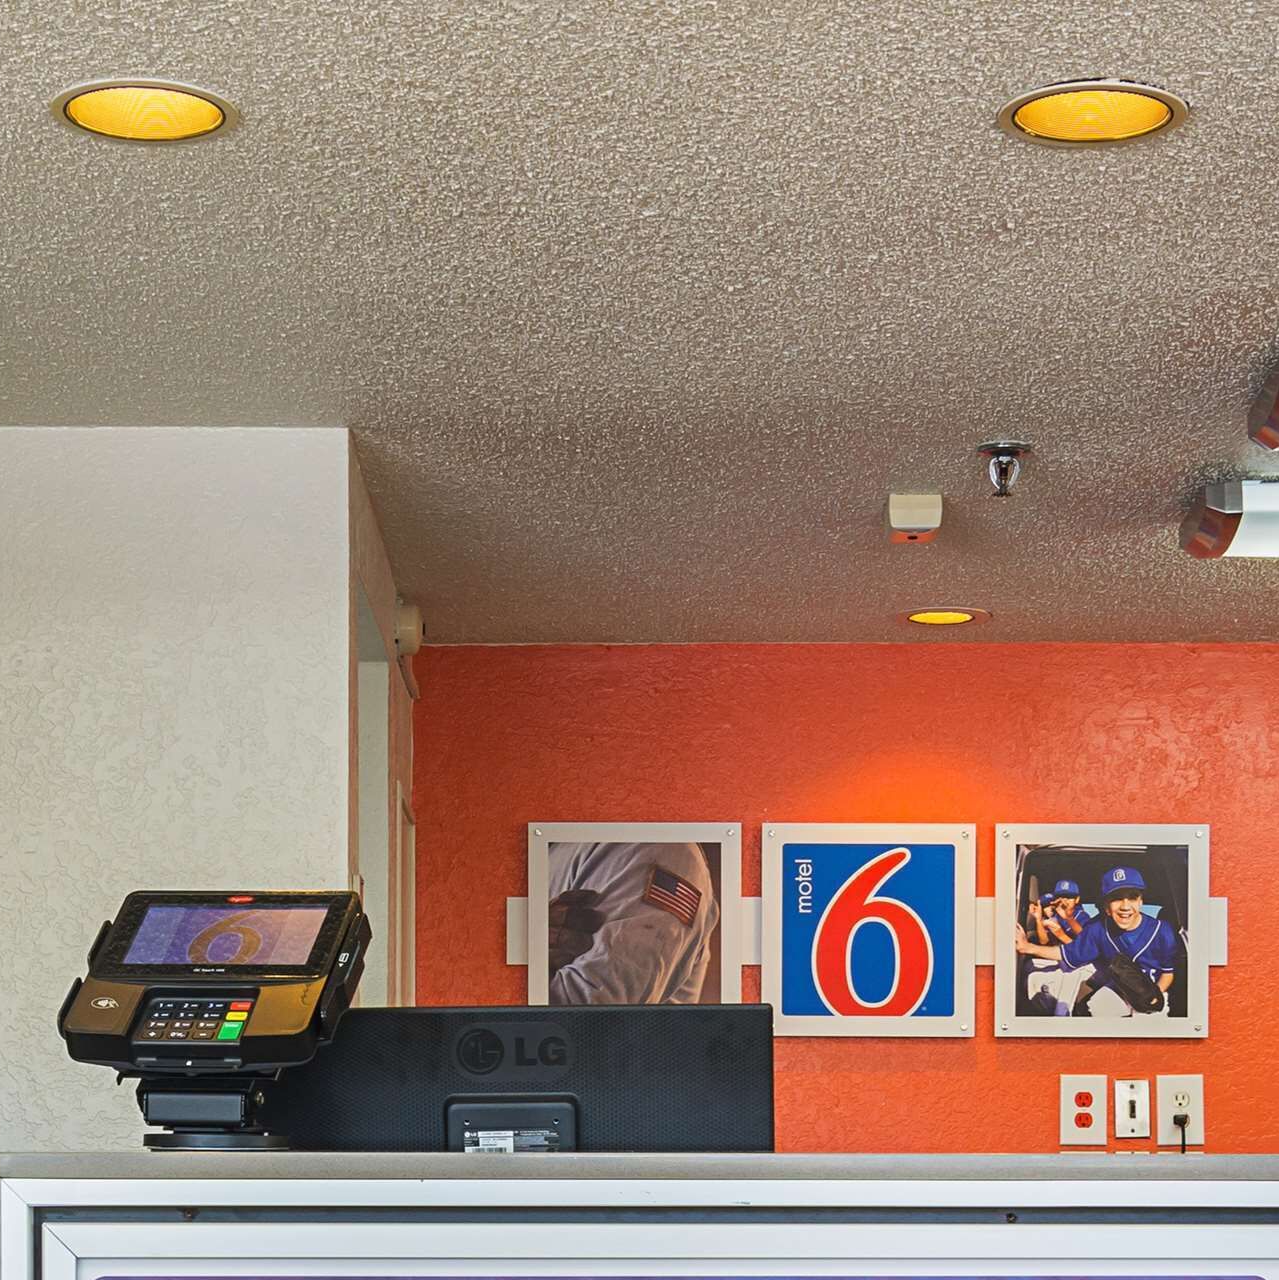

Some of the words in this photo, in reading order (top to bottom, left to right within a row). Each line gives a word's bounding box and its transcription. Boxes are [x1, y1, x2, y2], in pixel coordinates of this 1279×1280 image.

[795, 859, 812, 913] motel
[811, 847, 934, 1017] 6
[515, 1036, 568, 1066] LG
